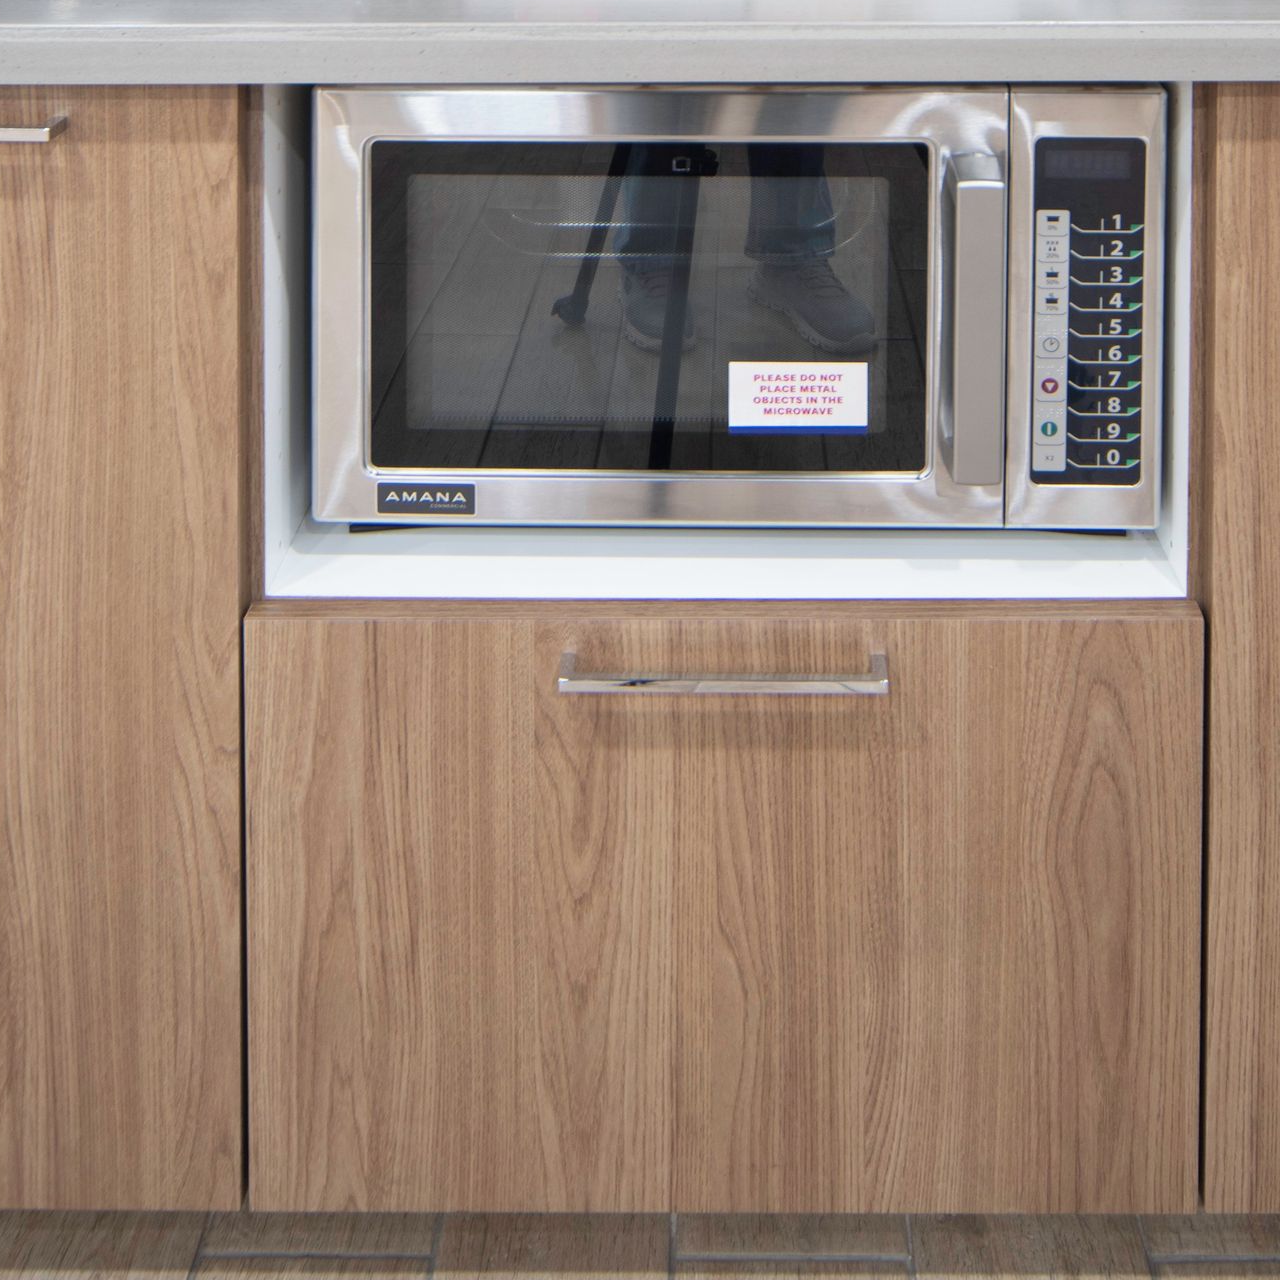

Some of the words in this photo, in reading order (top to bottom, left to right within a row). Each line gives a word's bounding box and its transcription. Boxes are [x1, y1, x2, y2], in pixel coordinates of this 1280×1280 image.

[1112, 214, 1122, 230] 1
[1110, 240, 1123, 256] 2
[1110, 266, 1123, 282] 3
[1109, 292, 1123, 308] 4
[1110, 319, 1122, 334] 5
[1108, 345, 1122, 361] 6
[753, 374, 797, 382] PLEASE
[800, 374, 816, 382] DO
[820, 374, 843, 382] NOT
[1108, 371, 1121, 387] 7
[760, 385, 796, 393] PLACE
[800, 385, 837, 393] METAL
[753, 396, 802, 404] OBJECTS
[806, 396, 818, 404] IN
[821, 396, 844, 404] THE
[1107, 397, 1121, 413] 8
[1107, 423, 1120, 439] 9
[1106, 449, 1120, 465] 0
[385, 491, 467, 503] AMANA
